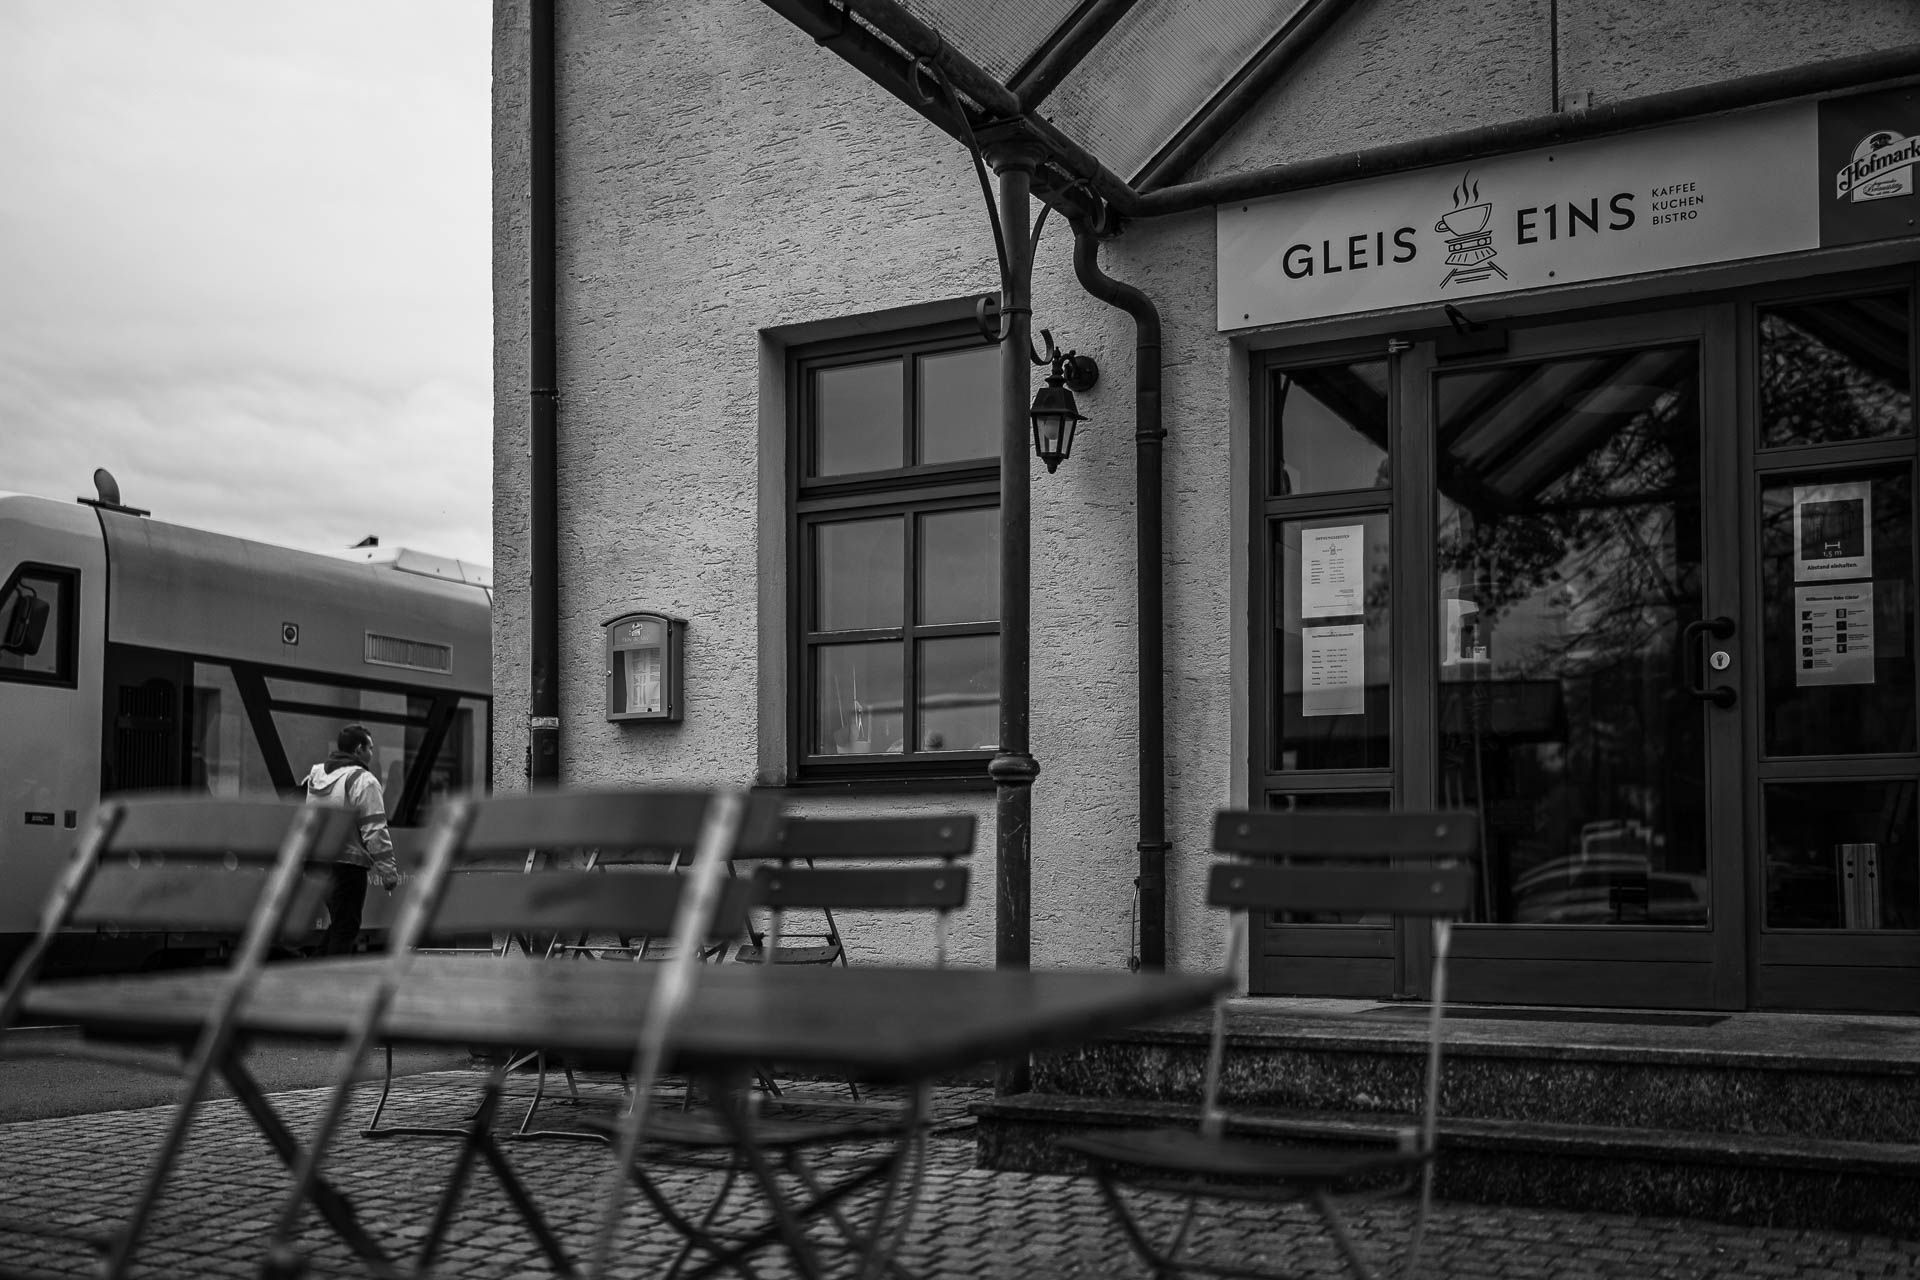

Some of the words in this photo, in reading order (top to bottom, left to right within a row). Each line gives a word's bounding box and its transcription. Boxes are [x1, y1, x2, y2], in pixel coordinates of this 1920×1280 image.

[1839, 139, 1920, 191] Hofmark
[1652, 182, 1696, 197] KAFFEE
[1652, 195, 1704, 212] KUCHEN
[1652, 210, 1698, 225] BISTRO
[1282, 227, 1417, 279] GLEIS
[1807, 563, 1830, 571] Abstand
